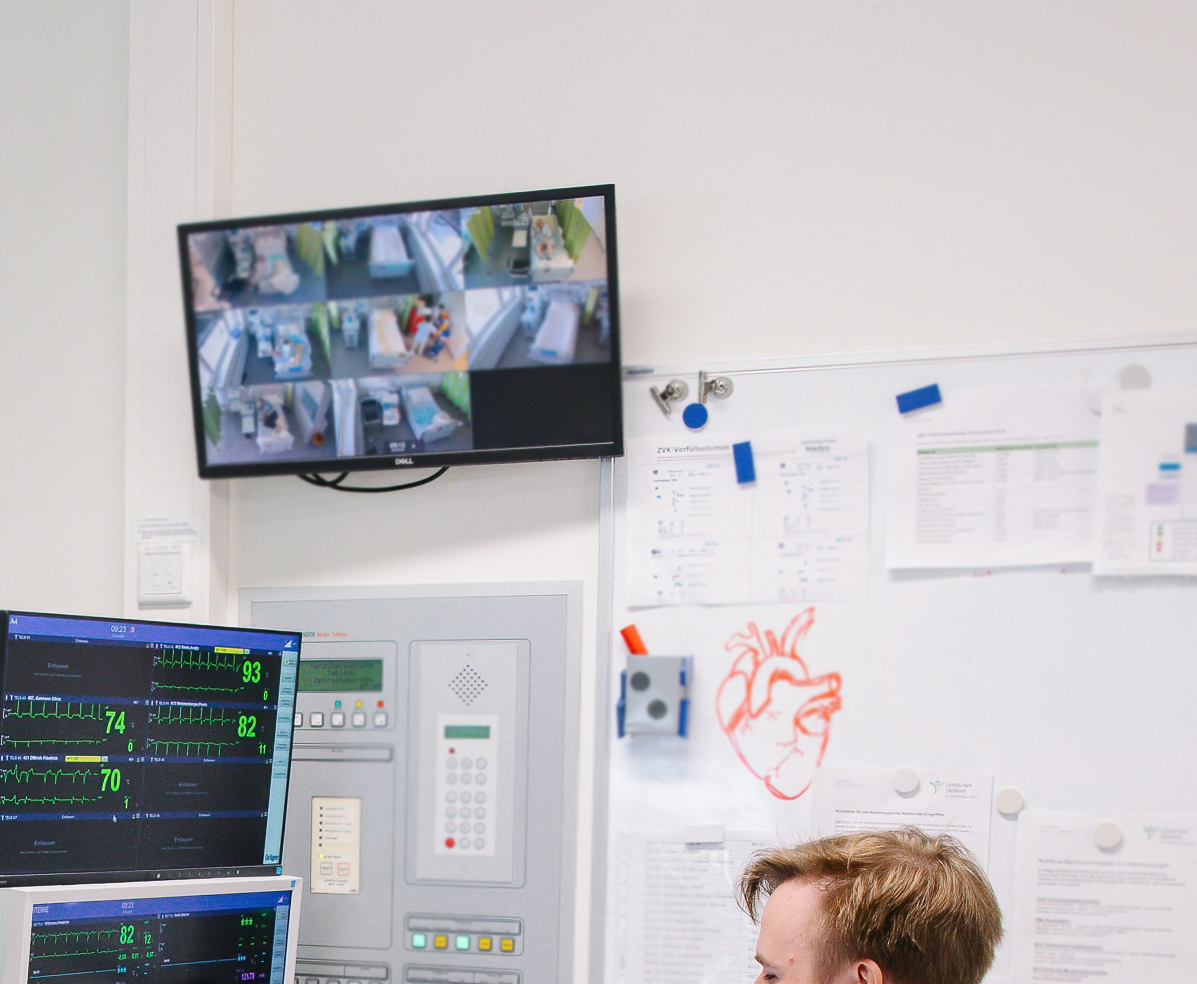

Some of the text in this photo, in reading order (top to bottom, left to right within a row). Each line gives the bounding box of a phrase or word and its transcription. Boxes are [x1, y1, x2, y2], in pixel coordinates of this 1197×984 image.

[395, 458, 414, 466] DELL
[111, 625, 127, 633] 09:23
[242, 660, 261, 684] 93
[263, 690, 269, 701] 0
[105, 711, 126, 734] 74
[237, 715, 257, 738] 82
[127, 742, 133, 752] 0
[259, 744, 267, 754] 11
[101, 768, 121, 792] 70
[124, 798, 128, 809] 1
[119, 925, 135, 945] 82
[144, 934, 152, 945] 12
